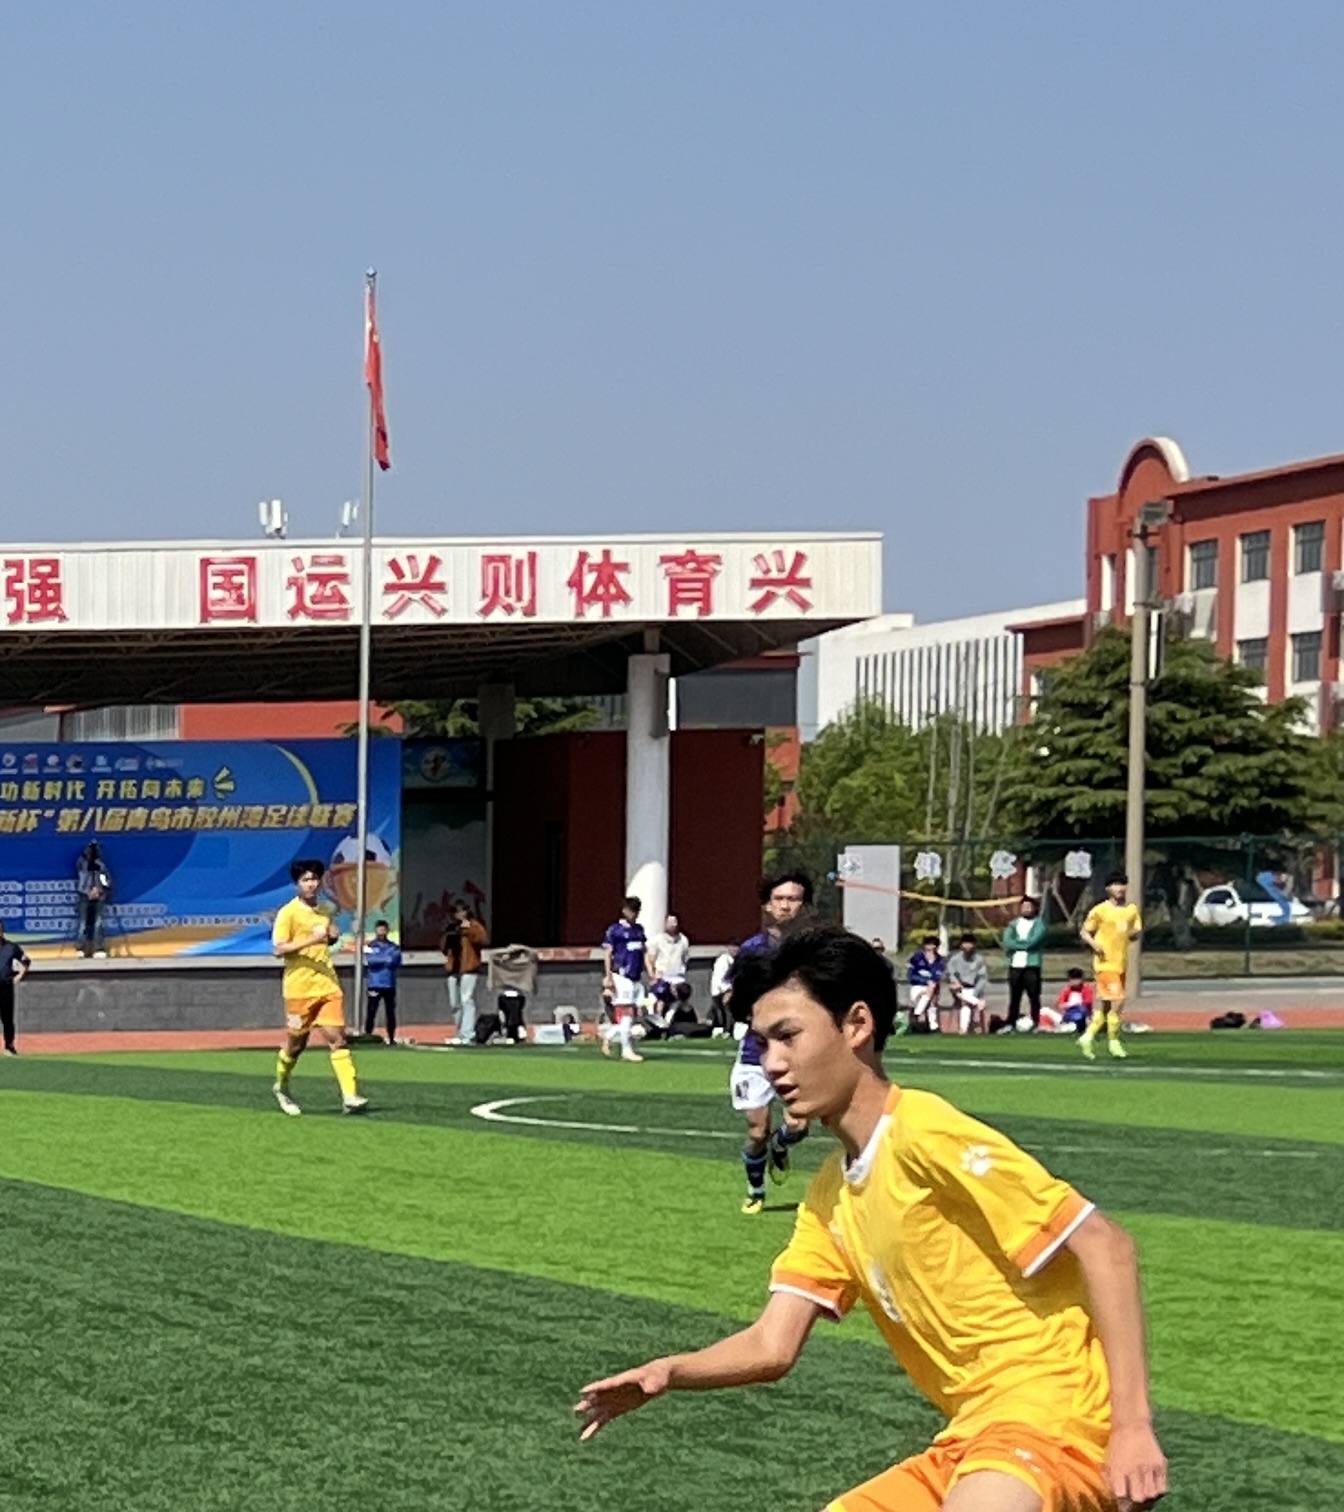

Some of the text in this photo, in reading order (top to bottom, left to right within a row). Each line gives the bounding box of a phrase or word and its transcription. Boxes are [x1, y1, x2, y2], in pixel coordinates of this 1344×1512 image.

[198, 549, 813, 623] 国运兴则体育兴
